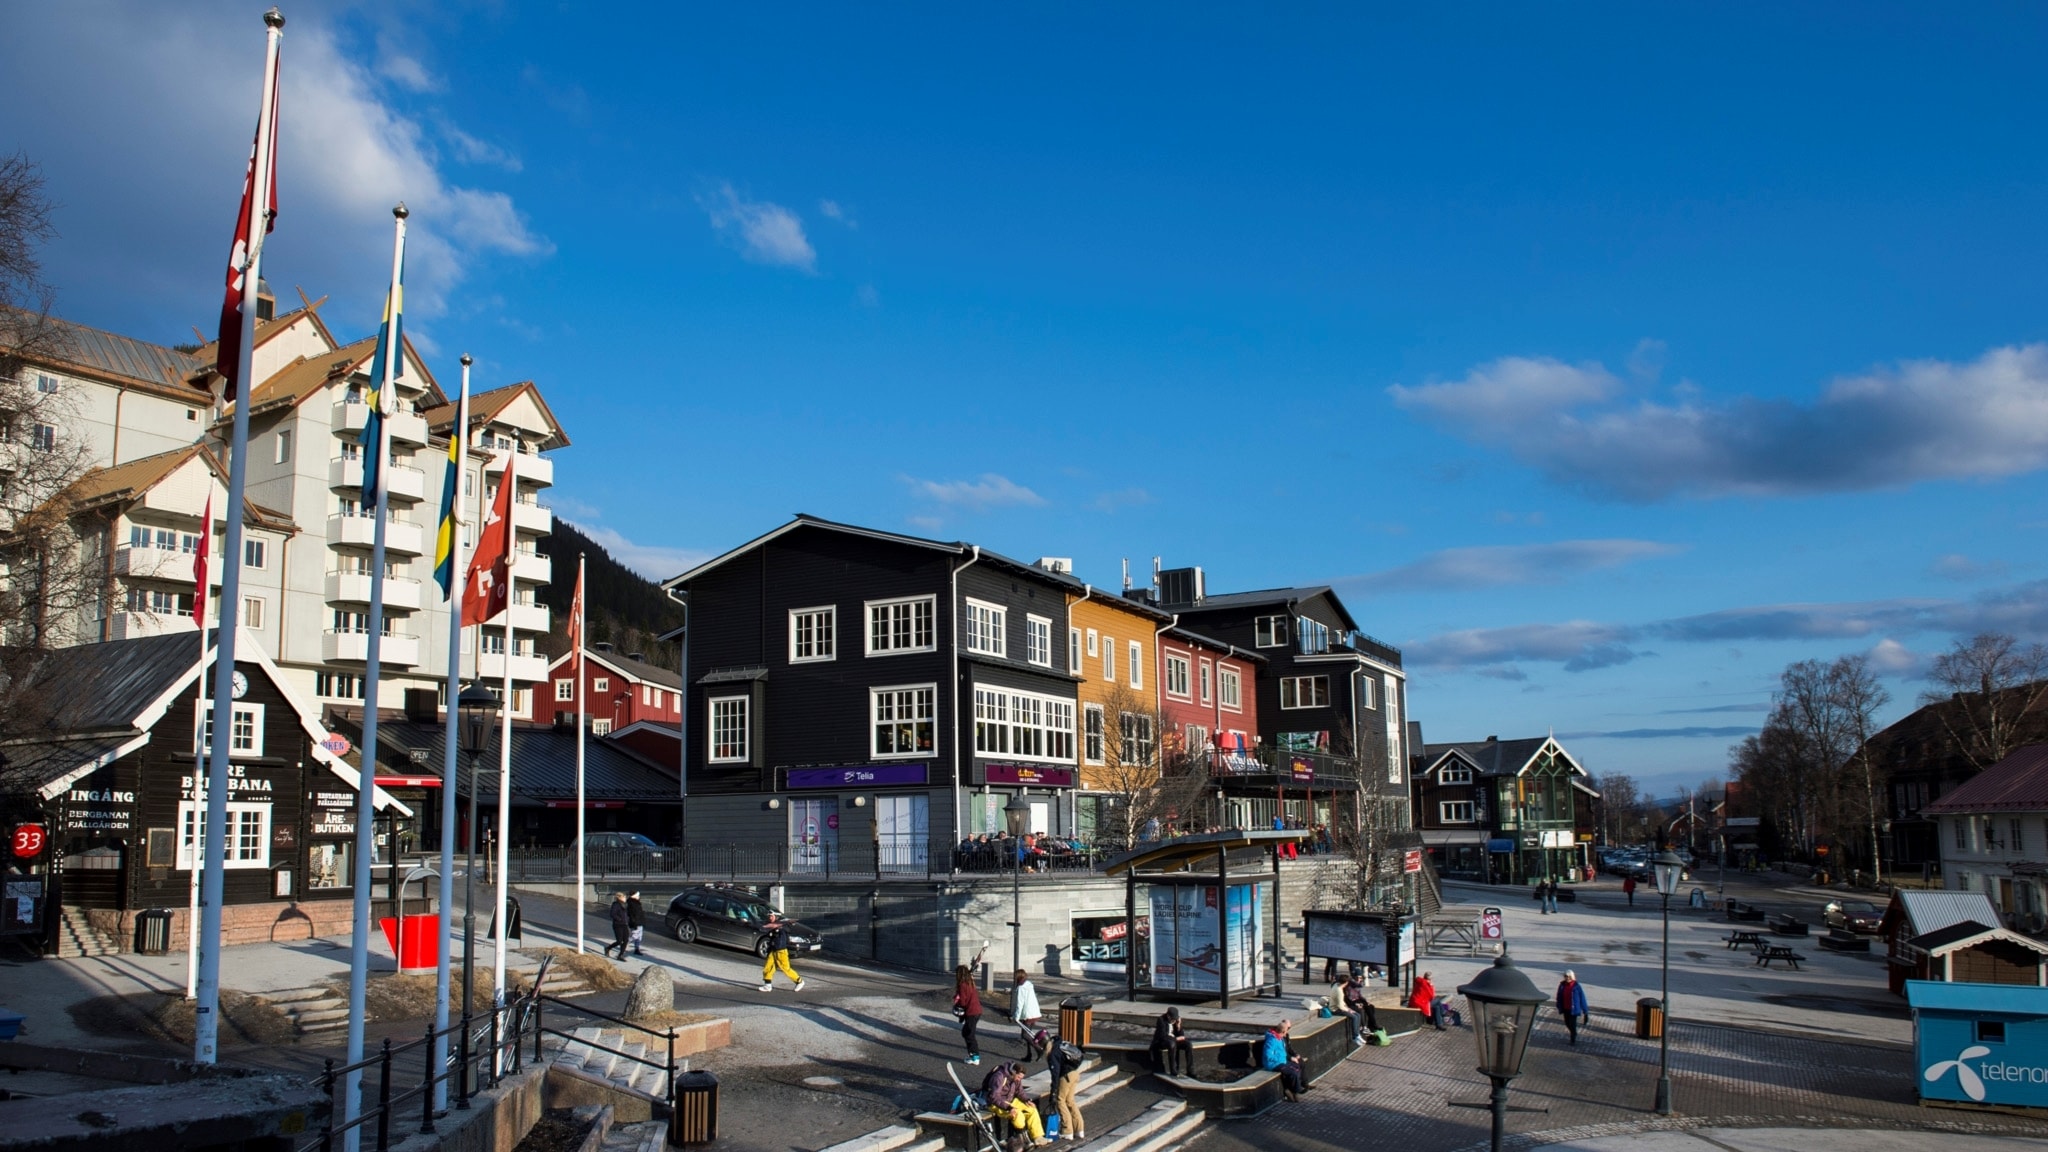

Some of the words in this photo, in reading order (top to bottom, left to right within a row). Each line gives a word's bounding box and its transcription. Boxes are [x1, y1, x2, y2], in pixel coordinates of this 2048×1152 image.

[320, 740, 345, 750] OKEN
[856, 772, 874, 780] Telia
[70, 788, 134, 802] INGÅNG
[68, 810, 129, 819] BERGBANAN
[324, 813, 346, 823] ÅRE-
[68, 821, 129, 829] FJÄLLGÅRDEN
[315, 824, 354, 833] BUTIKEN
[16, 832, 41, 849] 33
